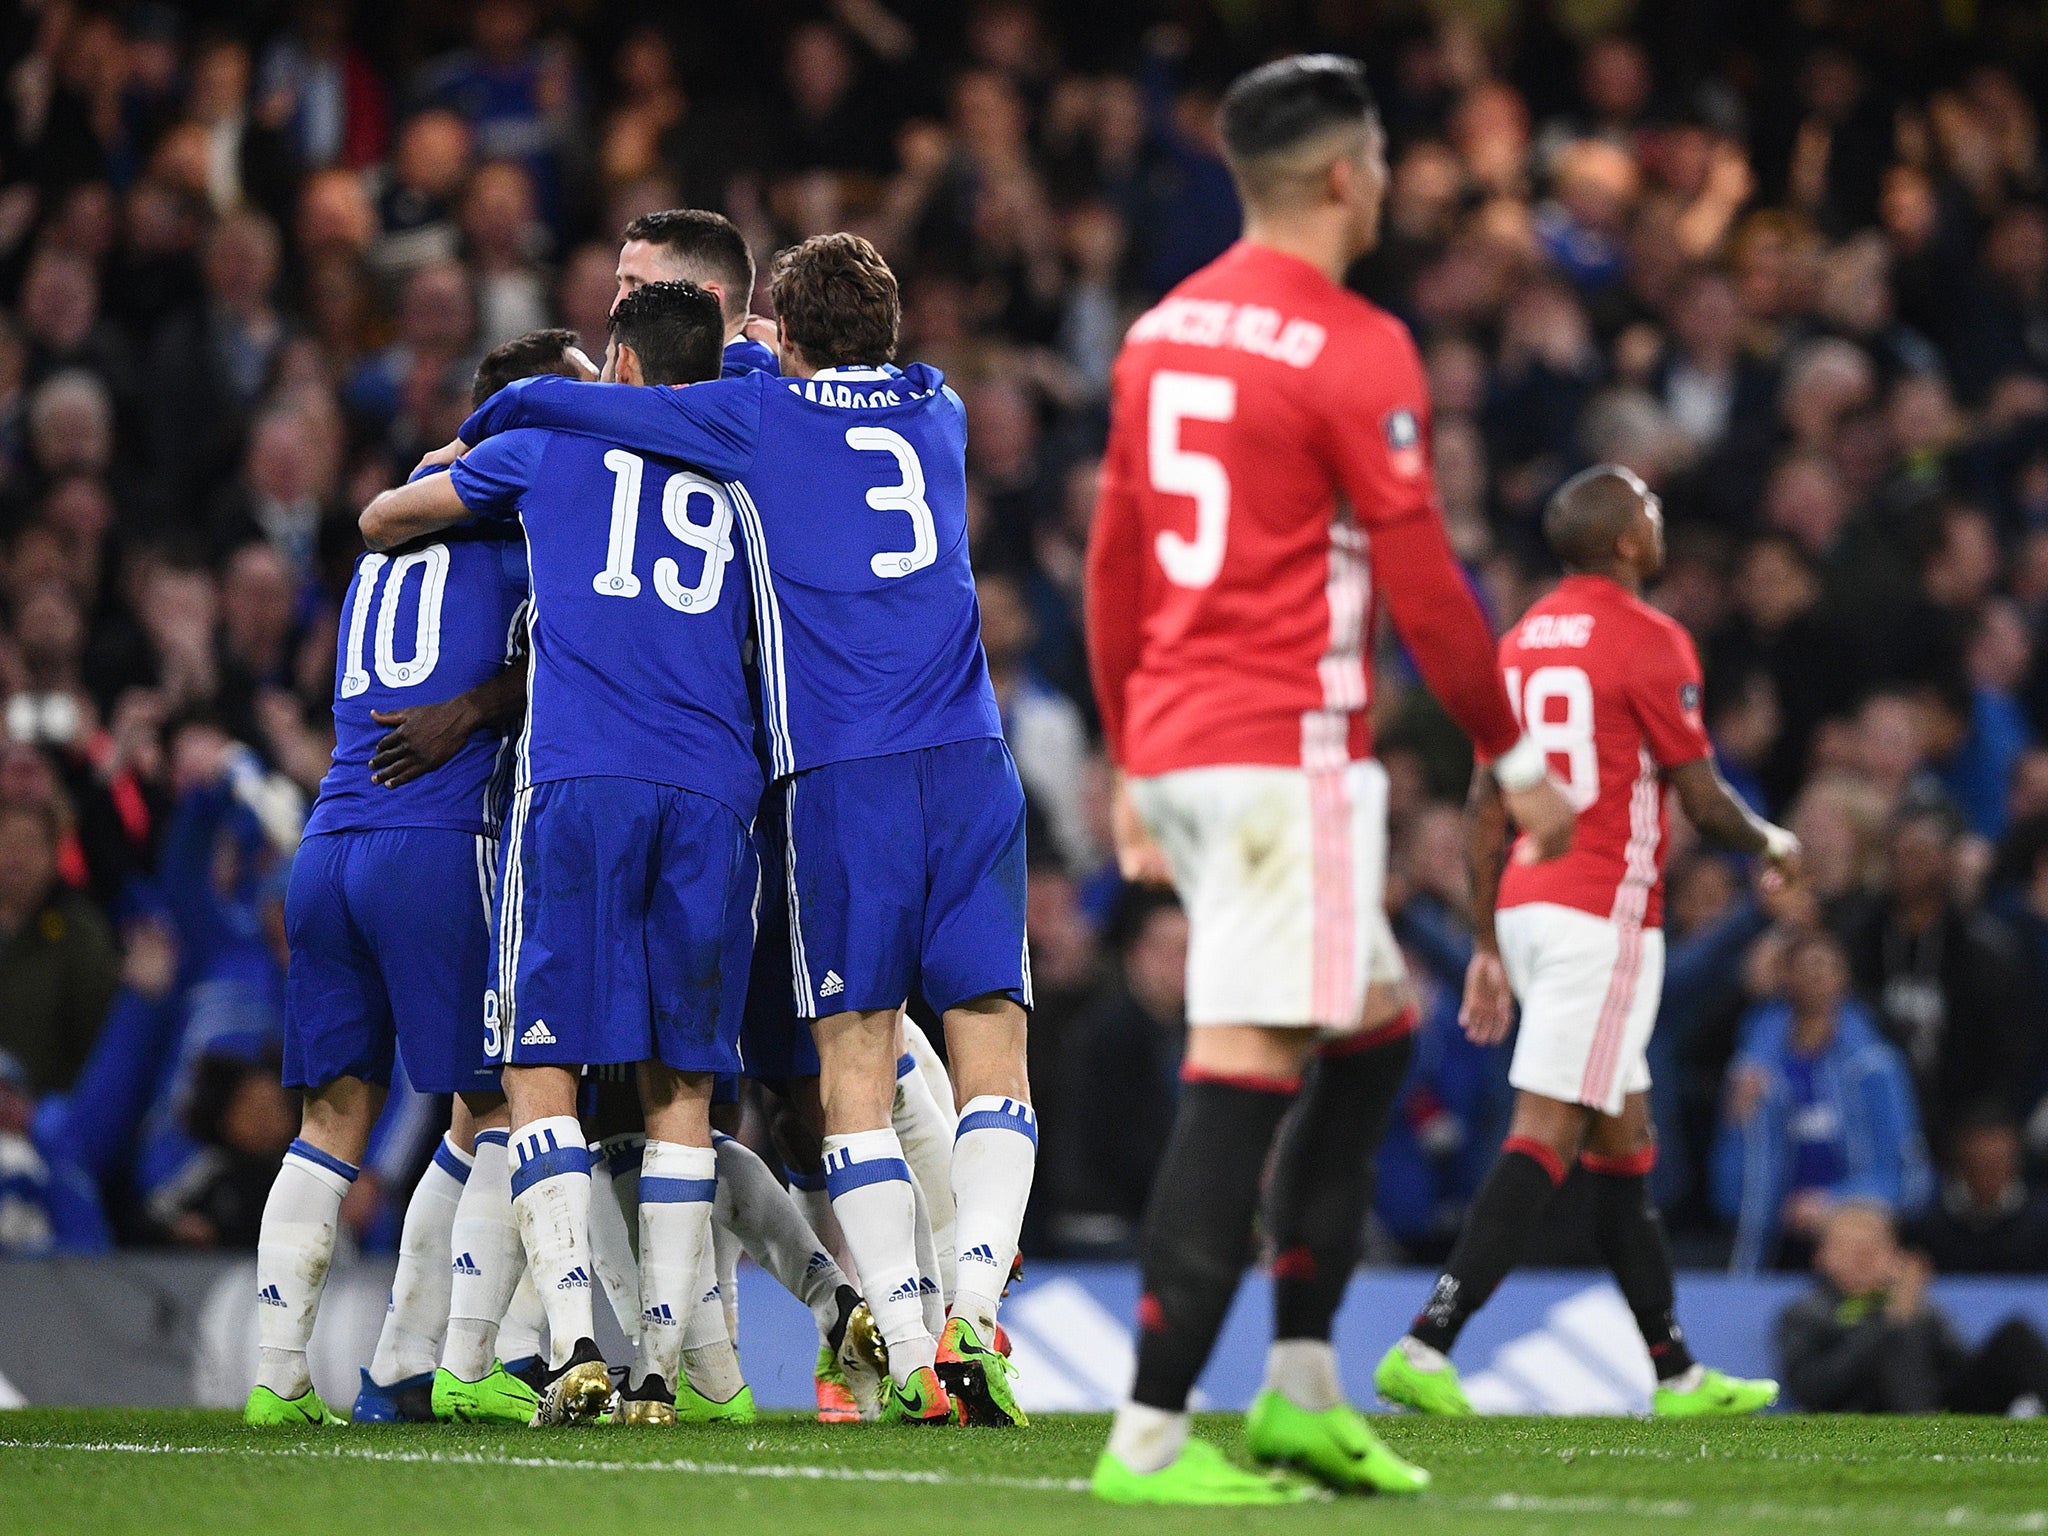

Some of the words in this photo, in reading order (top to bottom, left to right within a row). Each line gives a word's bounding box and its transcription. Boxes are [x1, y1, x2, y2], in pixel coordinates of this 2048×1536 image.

[846, 427, 938, 577] 3
[1149, 370, 1236, 588] 5
[593, 448, 735, 613] 19
[341, 543, 450, 699] 10
[484, 989, 501, 1057] 9
[521, 1034, 557, 1045] adidas
[958, 1253, 998, 1267] adidas
[641, 1313, 677, 1326] adidas
[888, 1289, 920, 1302] adida
